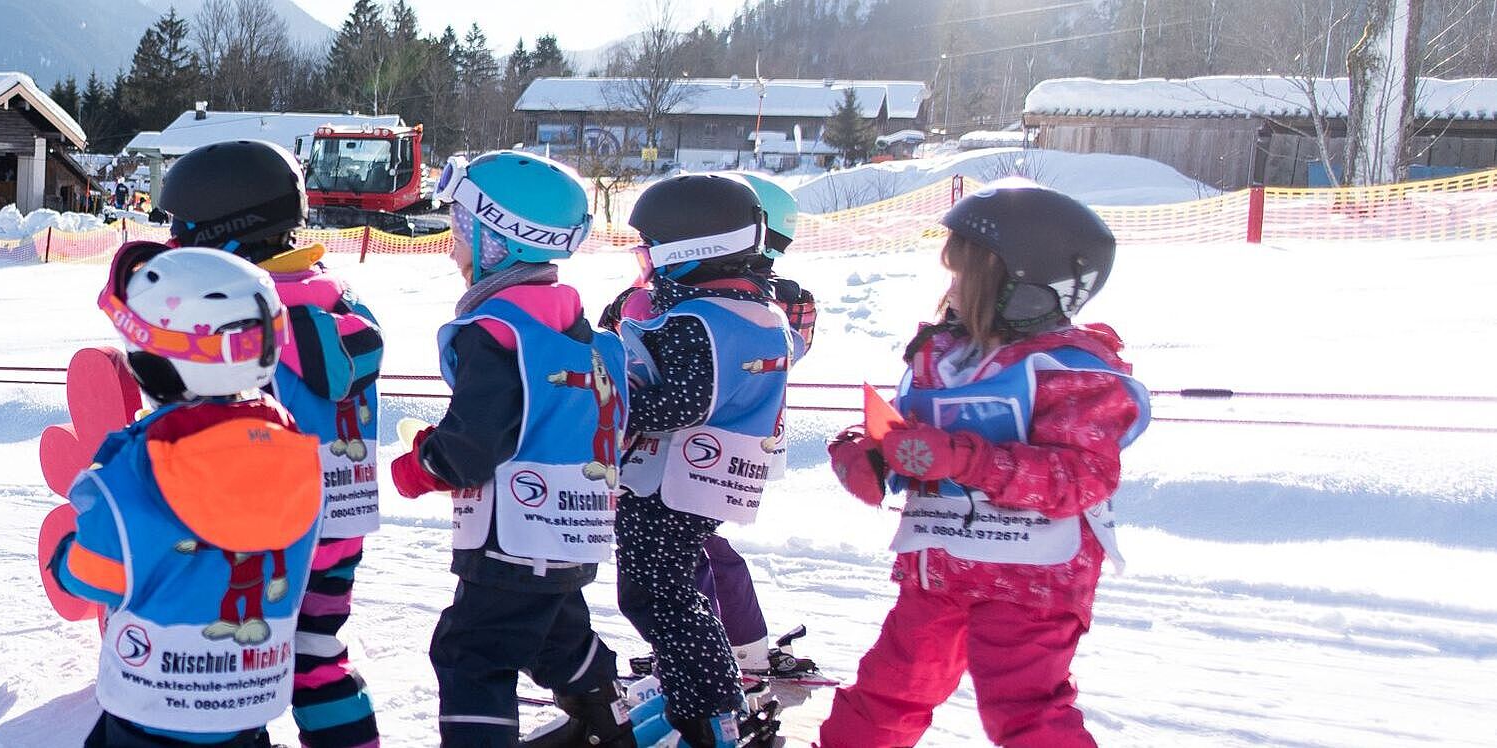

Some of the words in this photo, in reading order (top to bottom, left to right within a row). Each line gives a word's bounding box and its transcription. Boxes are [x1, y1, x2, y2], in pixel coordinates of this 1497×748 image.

[562, 533, 584, 544] Tel.
[161, 651, 237, 674] Skischule
[165, 696, 190, 709] Tel.
